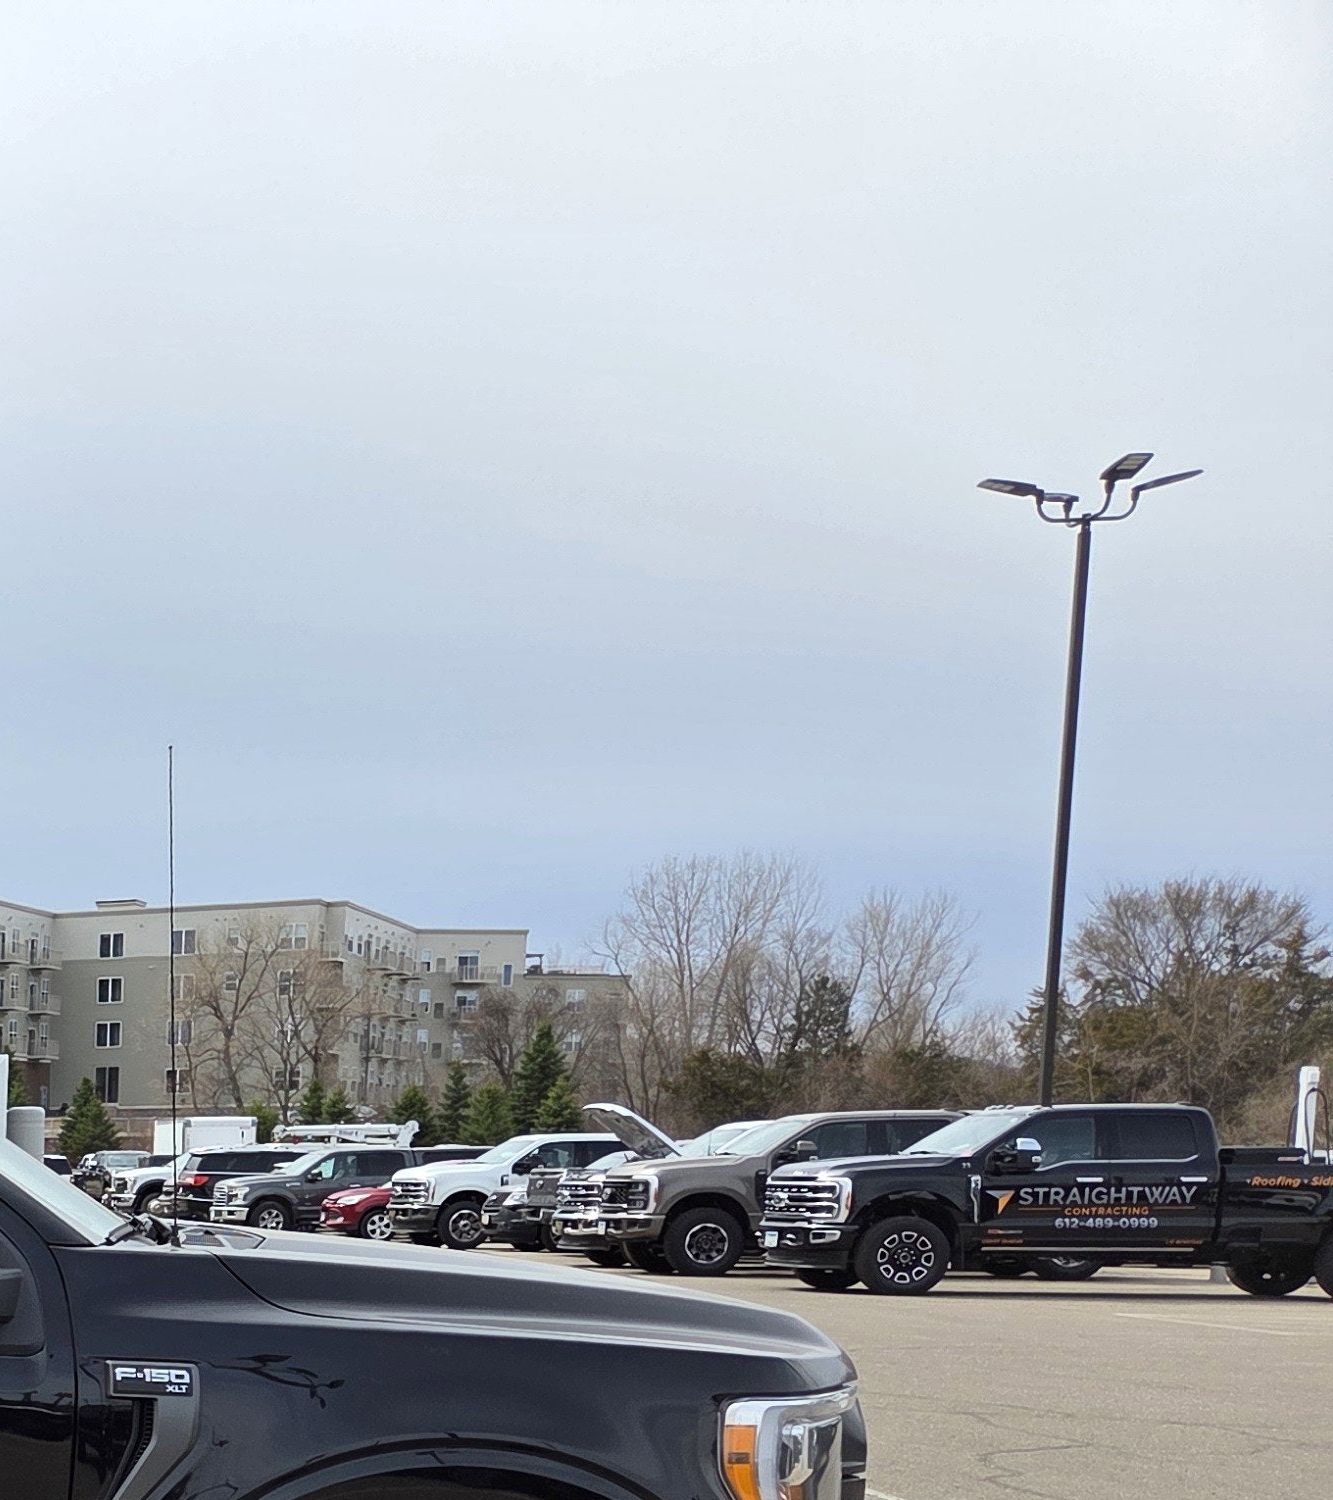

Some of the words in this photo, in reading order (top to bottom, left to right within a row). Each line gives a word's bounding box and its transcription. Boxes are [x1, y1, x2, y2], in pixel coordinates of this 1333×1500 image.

[1251, 1175, 1302, 1188] Roofing
[1018, 1185, 1198, 1205] STRAIGHTWAY
[1064, 1206, 1149, 1216] CONTRACTING
[1054, 1217, 1159, 1229] 612-489-0999
[115, 1367, 190, 1383] F-150
[165, 1385, 188, 1393] XLT
